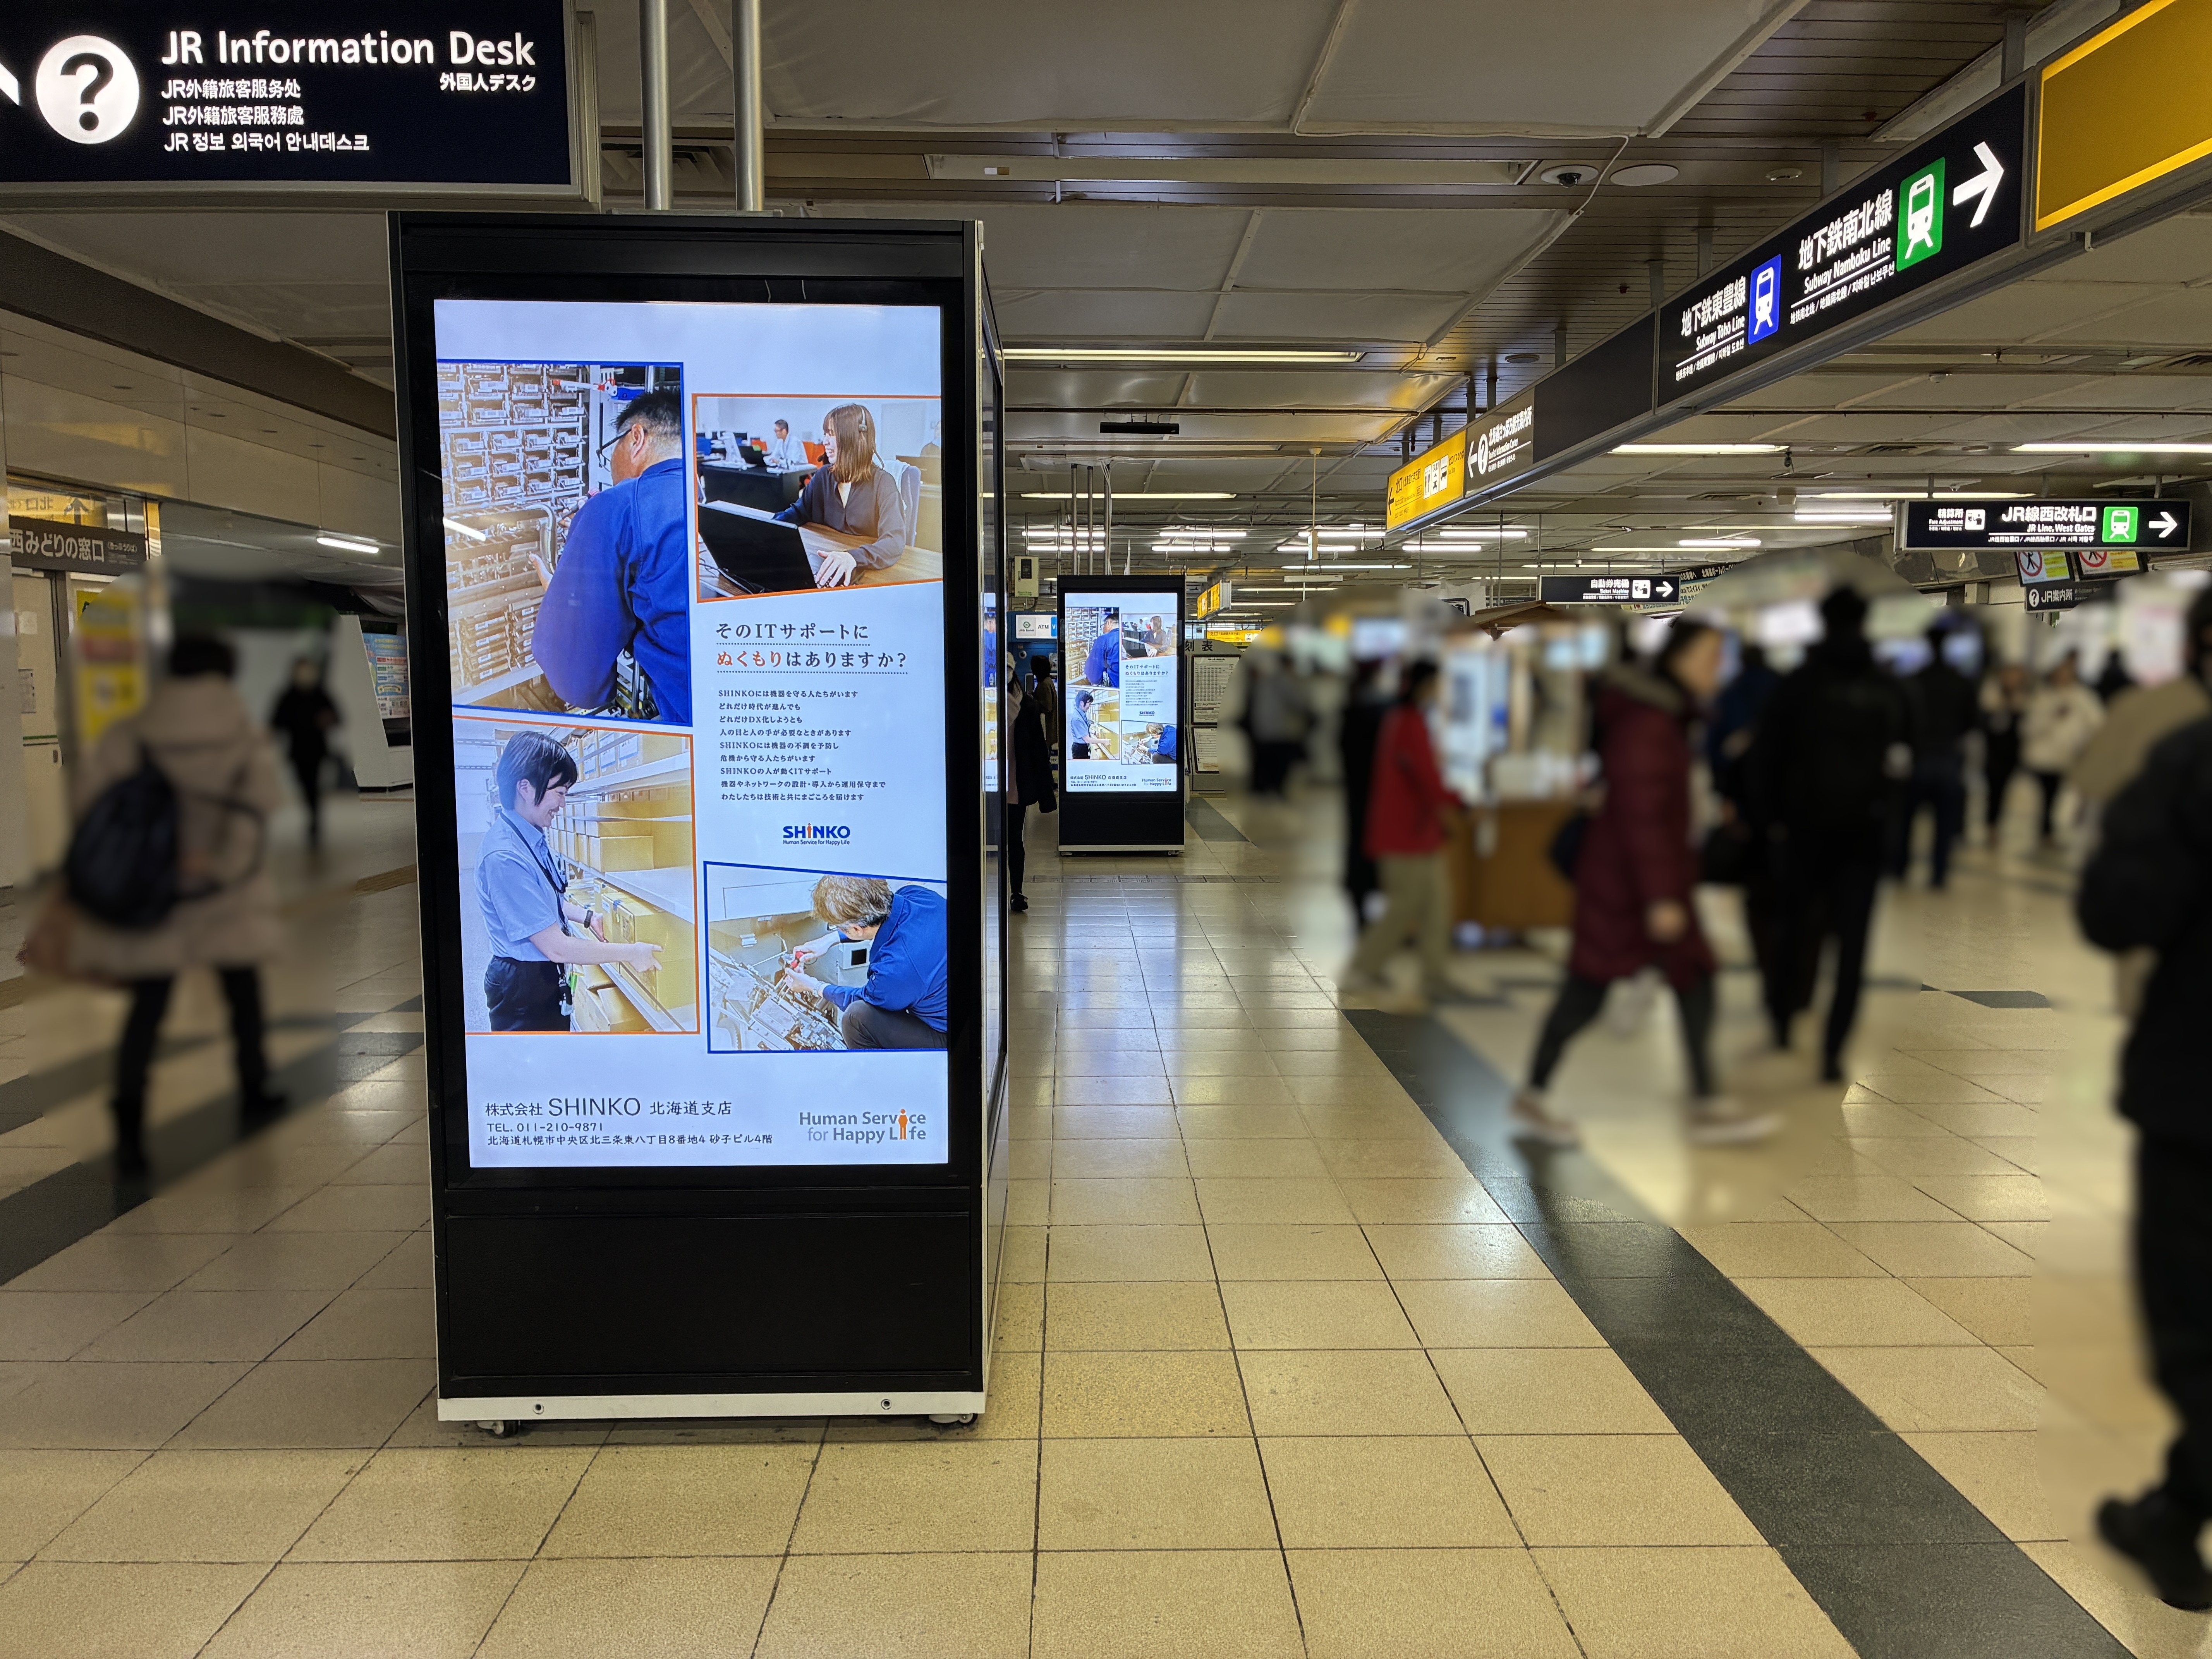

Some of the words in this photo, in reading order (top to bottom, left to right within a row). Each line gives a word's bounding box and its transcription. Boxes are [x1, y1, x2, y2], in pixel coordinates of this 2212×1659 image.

[161, 30, 202, 65] JR
[219, 29, 434, 65] Information
[449, 31, 536, 66] Desk
[161, 79, 301, 99] JR外籍旅客服务处
[439, 72, 536, 93] 外国人デスク
[163, 105, 304, 125] JR外籍旅客服務處
[164, 132, 189, 151] JR
[192, 132, 226, 151] 정보
[231, 132, 281, 151] 외국어
[286, 132, 370, 151] 안내데스크
[1798, 188, 1893, 270] 地下鉄南北線
[1804, 269, 1832, 294] Subway
[1834, 247, 1870, 279] Namboku
[1873, 237, 1891, 259] Line
[1681, 275, 1746, 337] 地下鉄東豊線
[1696, 331, 1717, 351] Subway
[1732, 315, 1745, 332] Line
[2001, 506, 2097, 522] JR線西改札口
[2027, 524, 2036, 532] JR
[2055, 524, 2073, 532] West
[2074, 524, 2095, 532] Gates
[9, 528, 105, 562] 西みどりの窓口
[2041, 588, 2073, 603] JR案内所
[716, 622, 869, 640] そのITサポートに
[717, 651, 907, 668] ぬくもりはありますか?
[485, 1102, 543, 1116] 株式会社
[548, 1097, 641, 1116] SHINKO
[649, 1101, 732, 1115] 北海道支店
[487, 1123, 513, 1132] TEL.
[517, 1123, 603, 1132] 011-210-9871
[800, 1111, 857, 1125] Human
[488, 1135, 705, 1146] 北海道札幌市中央区北三条東八丁目8番地4
[808, 1127, 828, 1141] for
[833, 1127, 885, 1144] Happy
